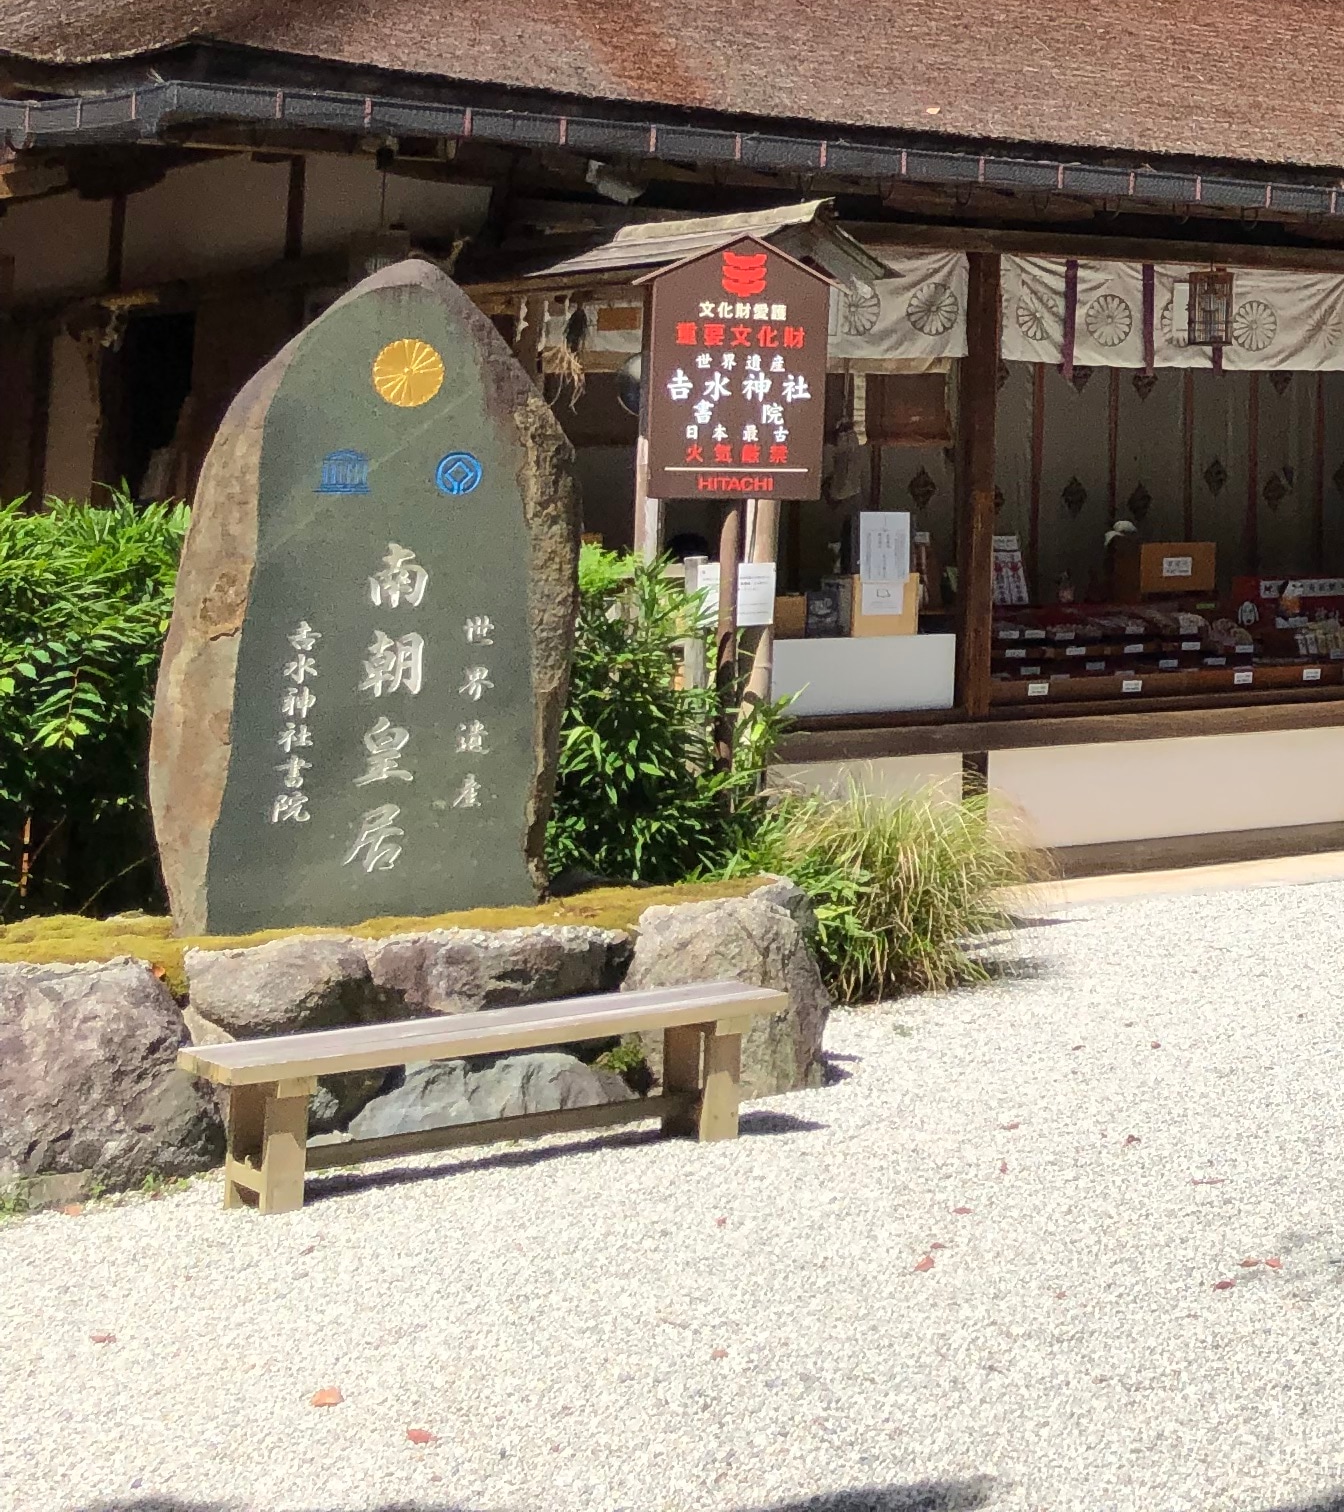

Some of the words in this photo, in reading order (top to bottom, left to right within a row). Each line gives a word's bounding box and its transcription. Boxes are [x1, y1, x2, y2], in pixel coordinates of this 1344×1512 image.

[699, 301, 787, 320] 文化財愛護
[676, 322, 805, 348] 重要文化財
[696, 353, 785, 372] 世界遺産
[686, 424, 789, 442] 日本最古
[686, 444, 788, 463] 火気厳禁
[698, 476, 774, 491] HITACHI
[341, 542, 429, 874] 南朝皇居
[451, 614, 495, 809] 世界遺産
